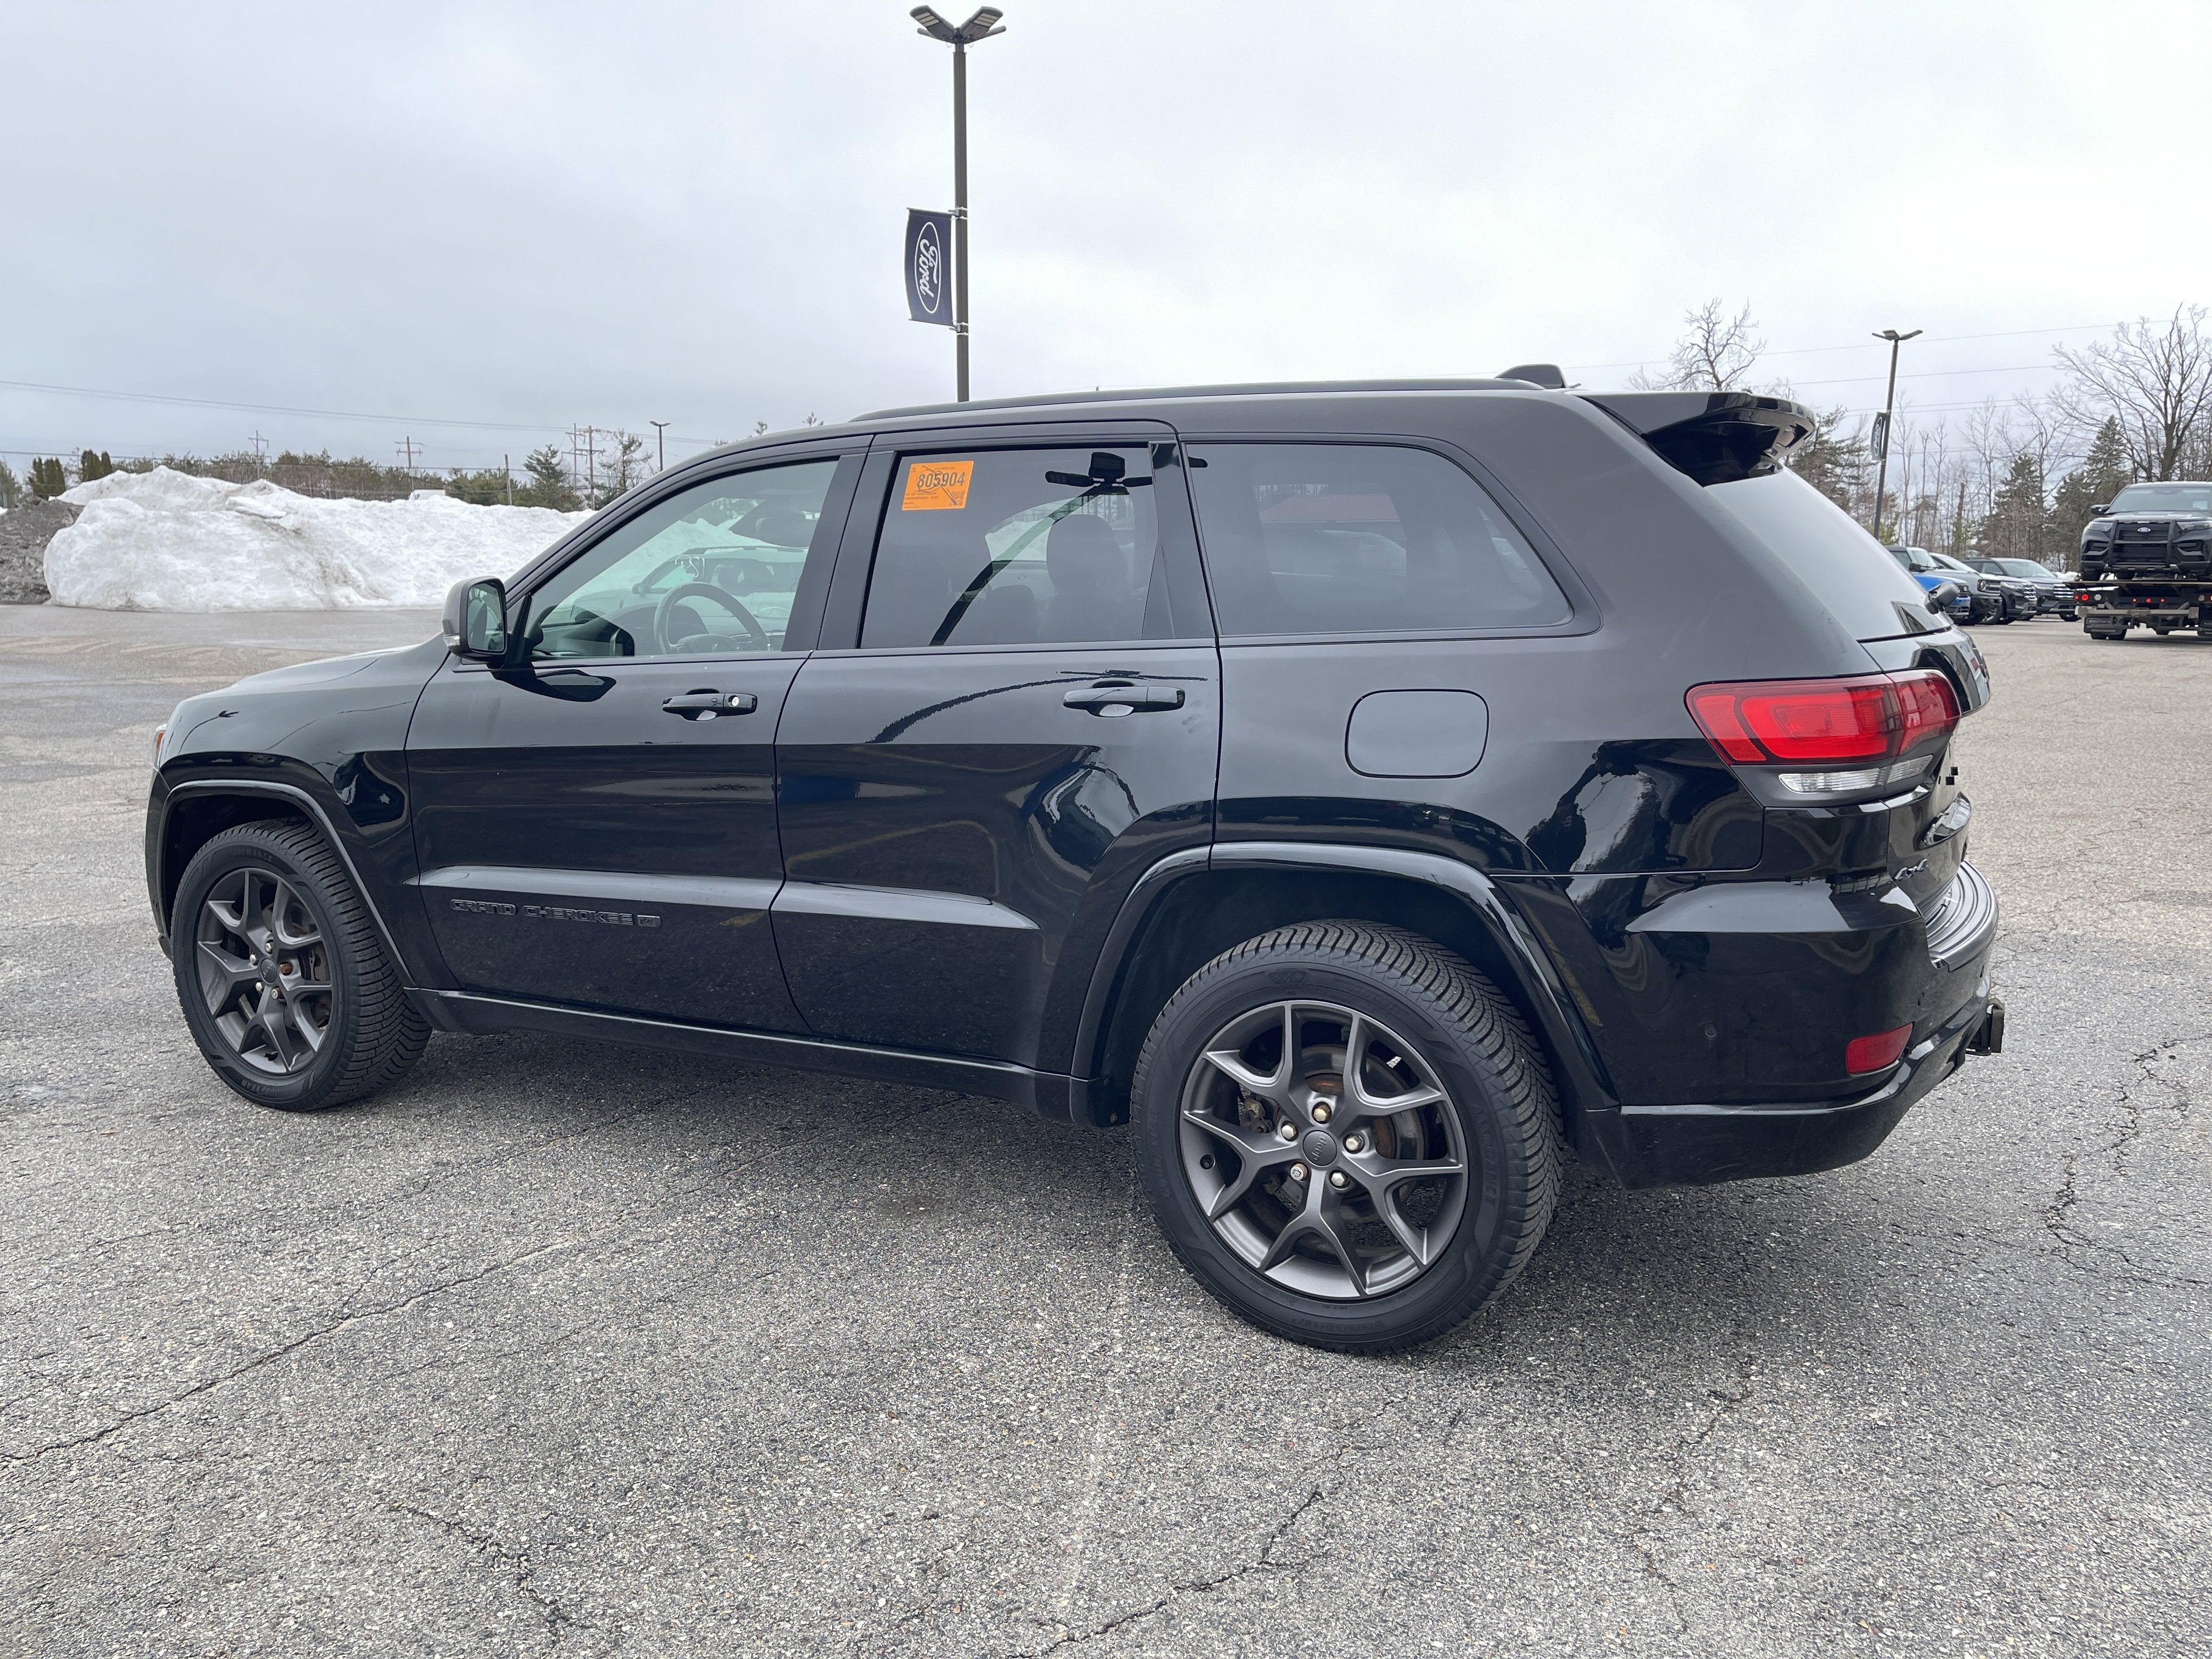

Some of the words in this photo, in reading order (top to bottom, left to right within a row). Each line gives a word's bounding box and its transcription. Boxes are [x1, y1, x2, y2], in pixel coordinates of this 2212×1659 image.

[919, 239, 938, 297] Ford
[917, 471, 966, 488] 805904
[450, 899, 517, 915] GRAND
[523, 905, 634, 926] CHEROKEE
[1311, 1136, 1327, 1160] Jeep
